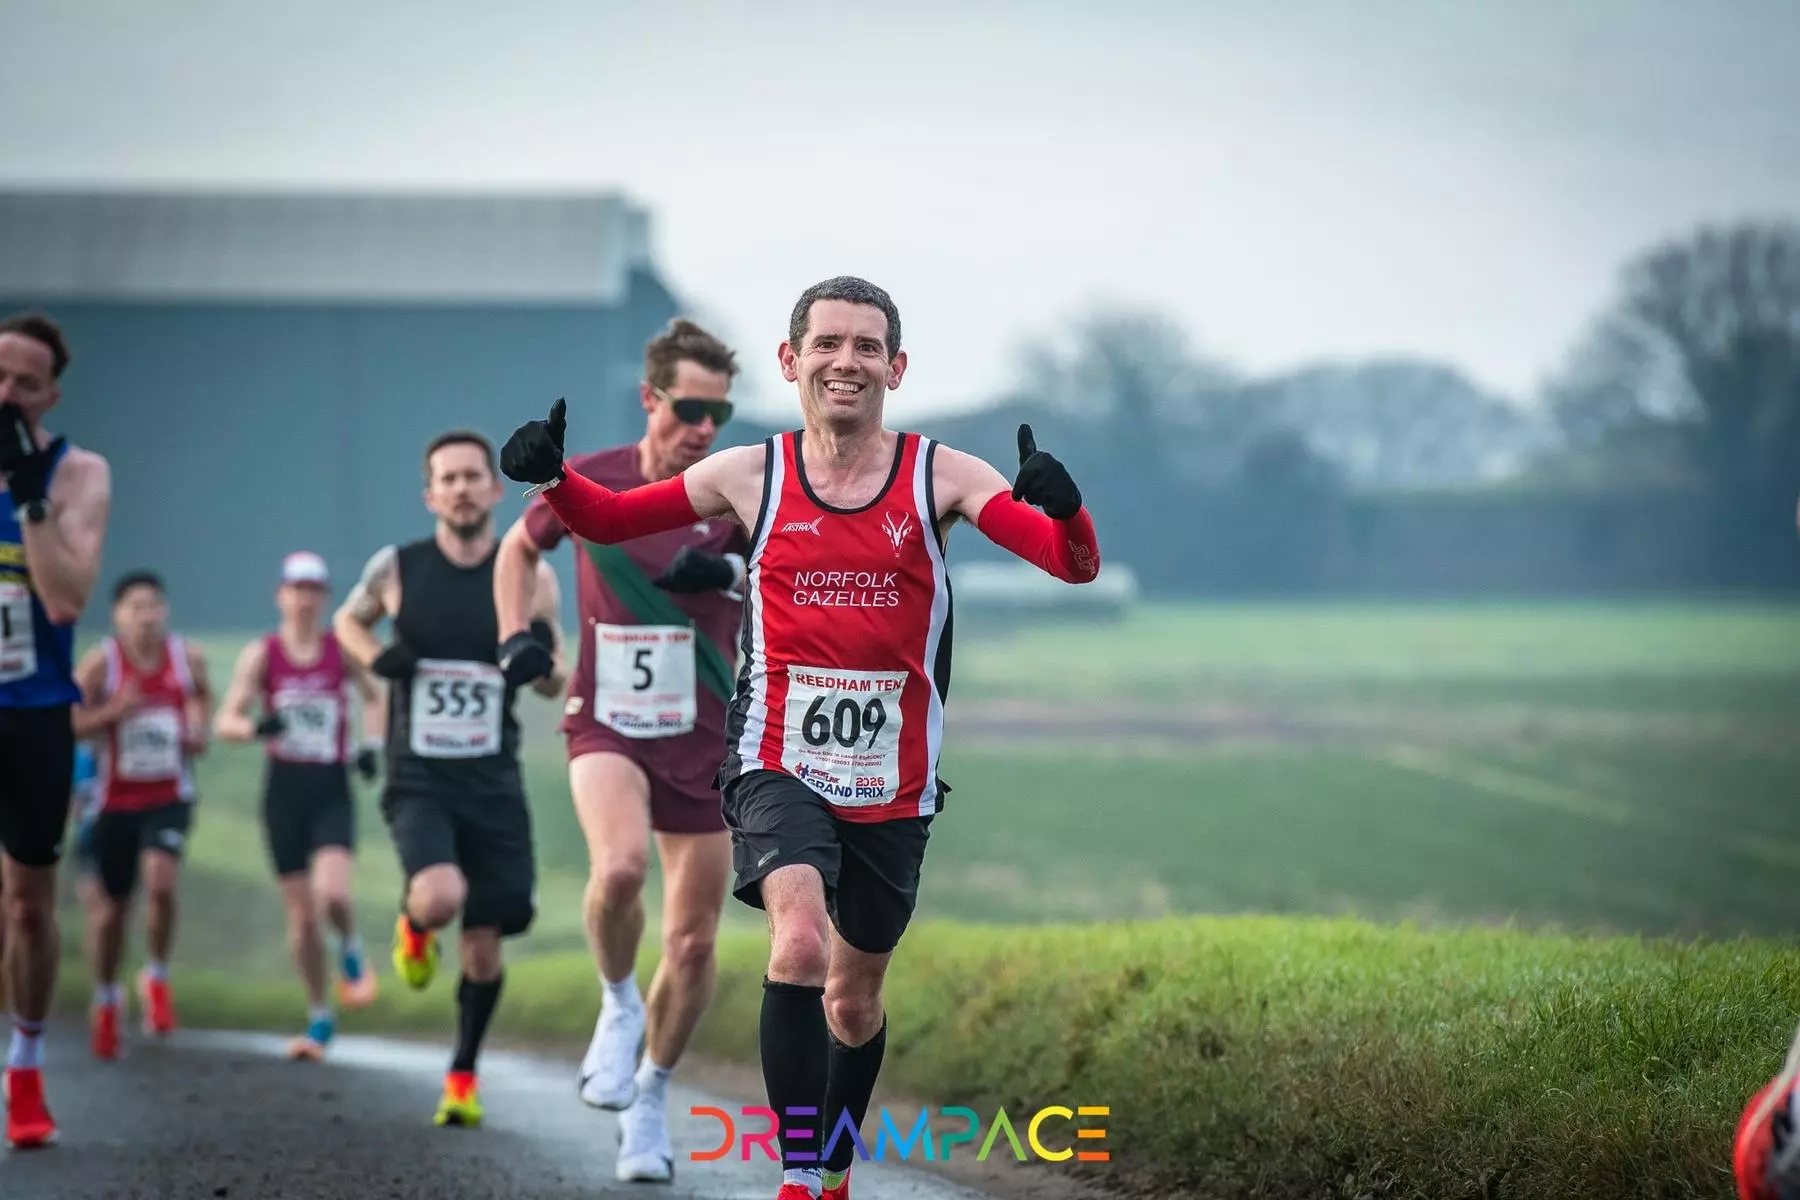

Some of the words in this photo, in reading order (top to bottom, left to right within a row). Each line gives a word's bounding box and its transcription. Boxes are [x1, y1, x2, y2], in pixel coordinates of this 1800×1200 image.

[795, 571, 898, 588] NORFOLK
[793, 590, 900, 607] GAZELLES
[633, 649, 653, 691] 5
[795, 673, 871, 692] REEDHAM
[876, 680, 902, 691] TEN
[428, 681, 487, 717] 555
[802, 695, 887, 749] 609
[807, 778, 852, 797] GRAND
[856, 787, 884, 798] PRIX
